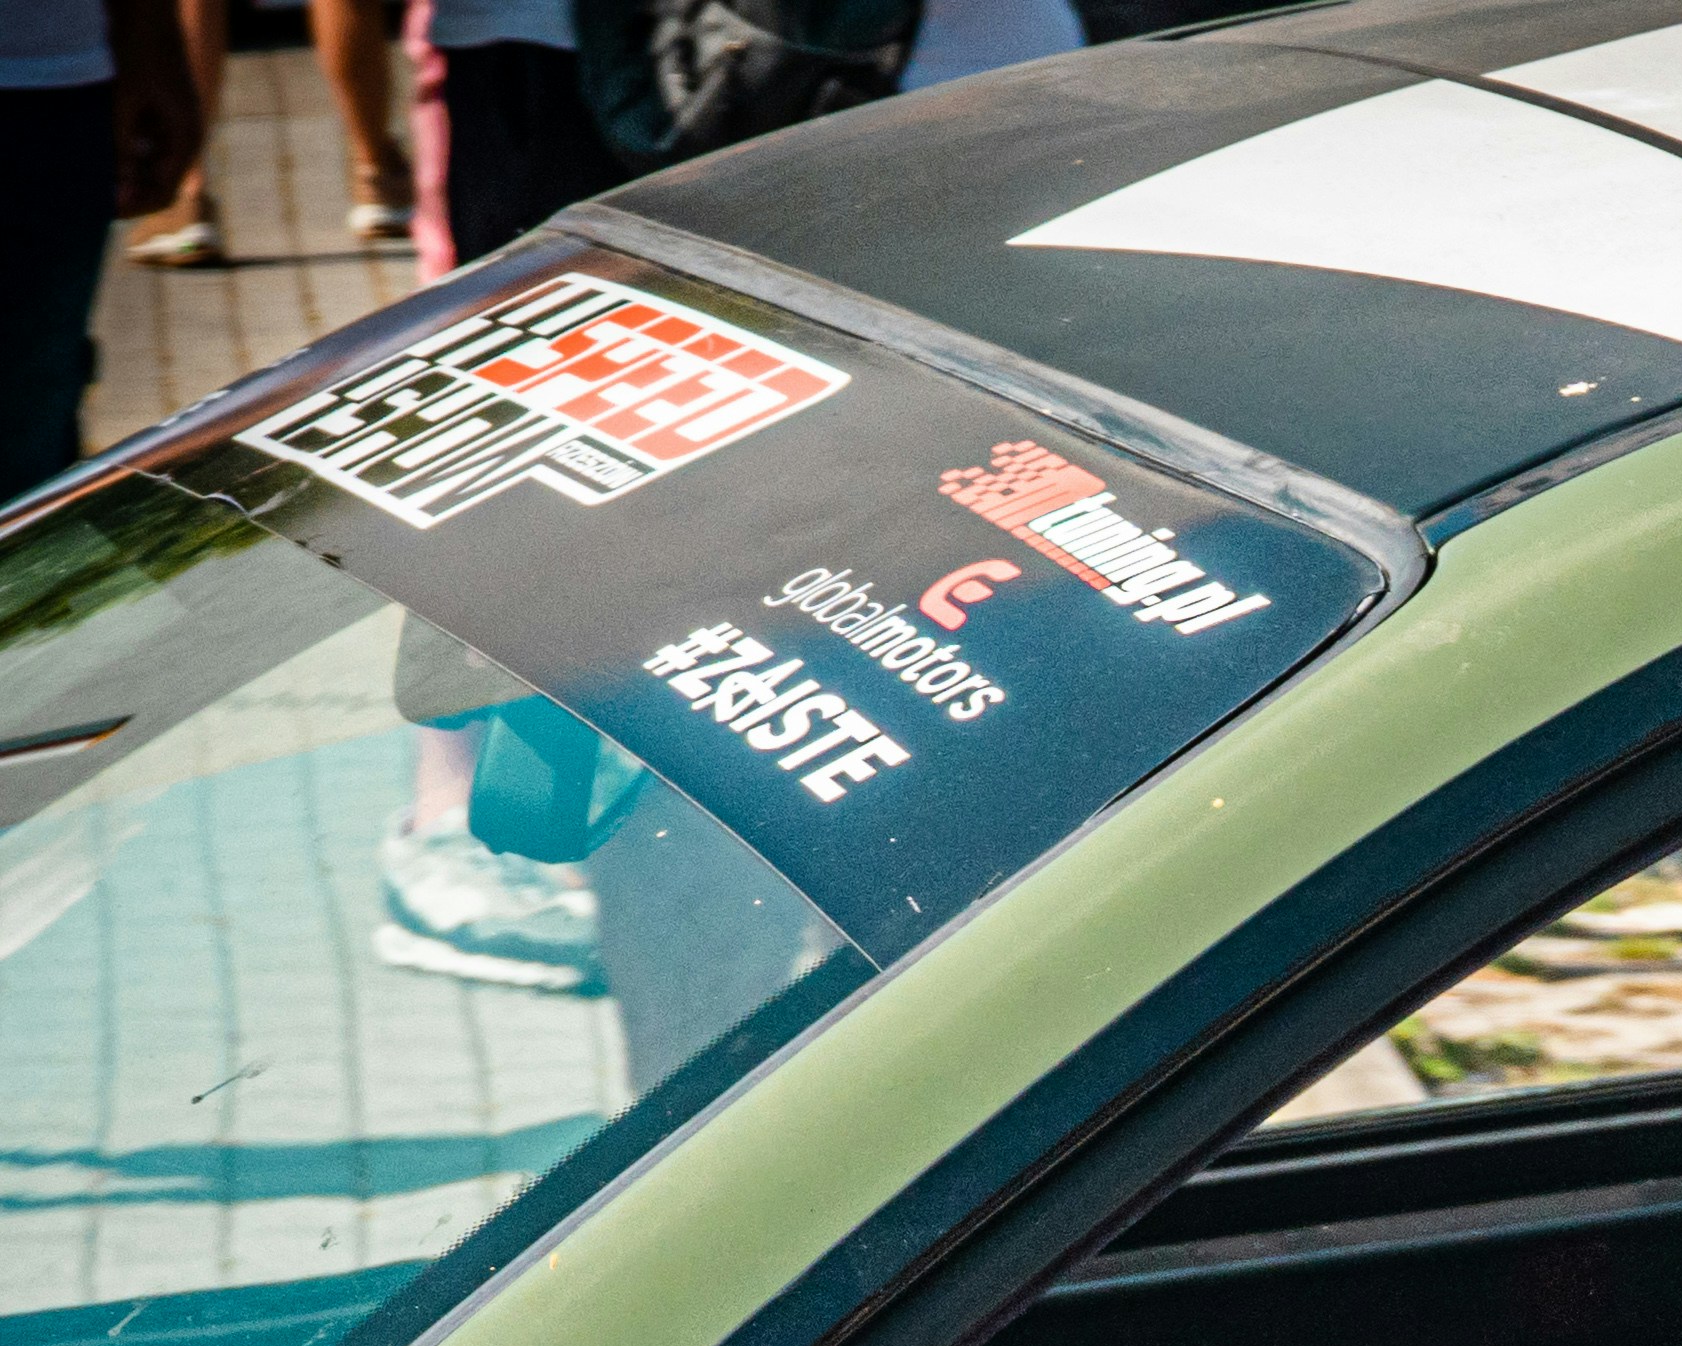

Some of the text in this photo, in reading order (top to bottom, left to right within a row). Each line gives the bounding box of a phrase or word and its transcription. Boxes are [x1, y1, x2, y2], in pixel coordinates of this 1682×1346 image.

[264, 370, 572, 517] SHOW
[471, 302, 832, 461] SPEED
[547, 437, 646, 489] RZESZÓW
[642, 620, 912, 804] #ZAISTE
[762, 564, 1008, 723] globalmotors
